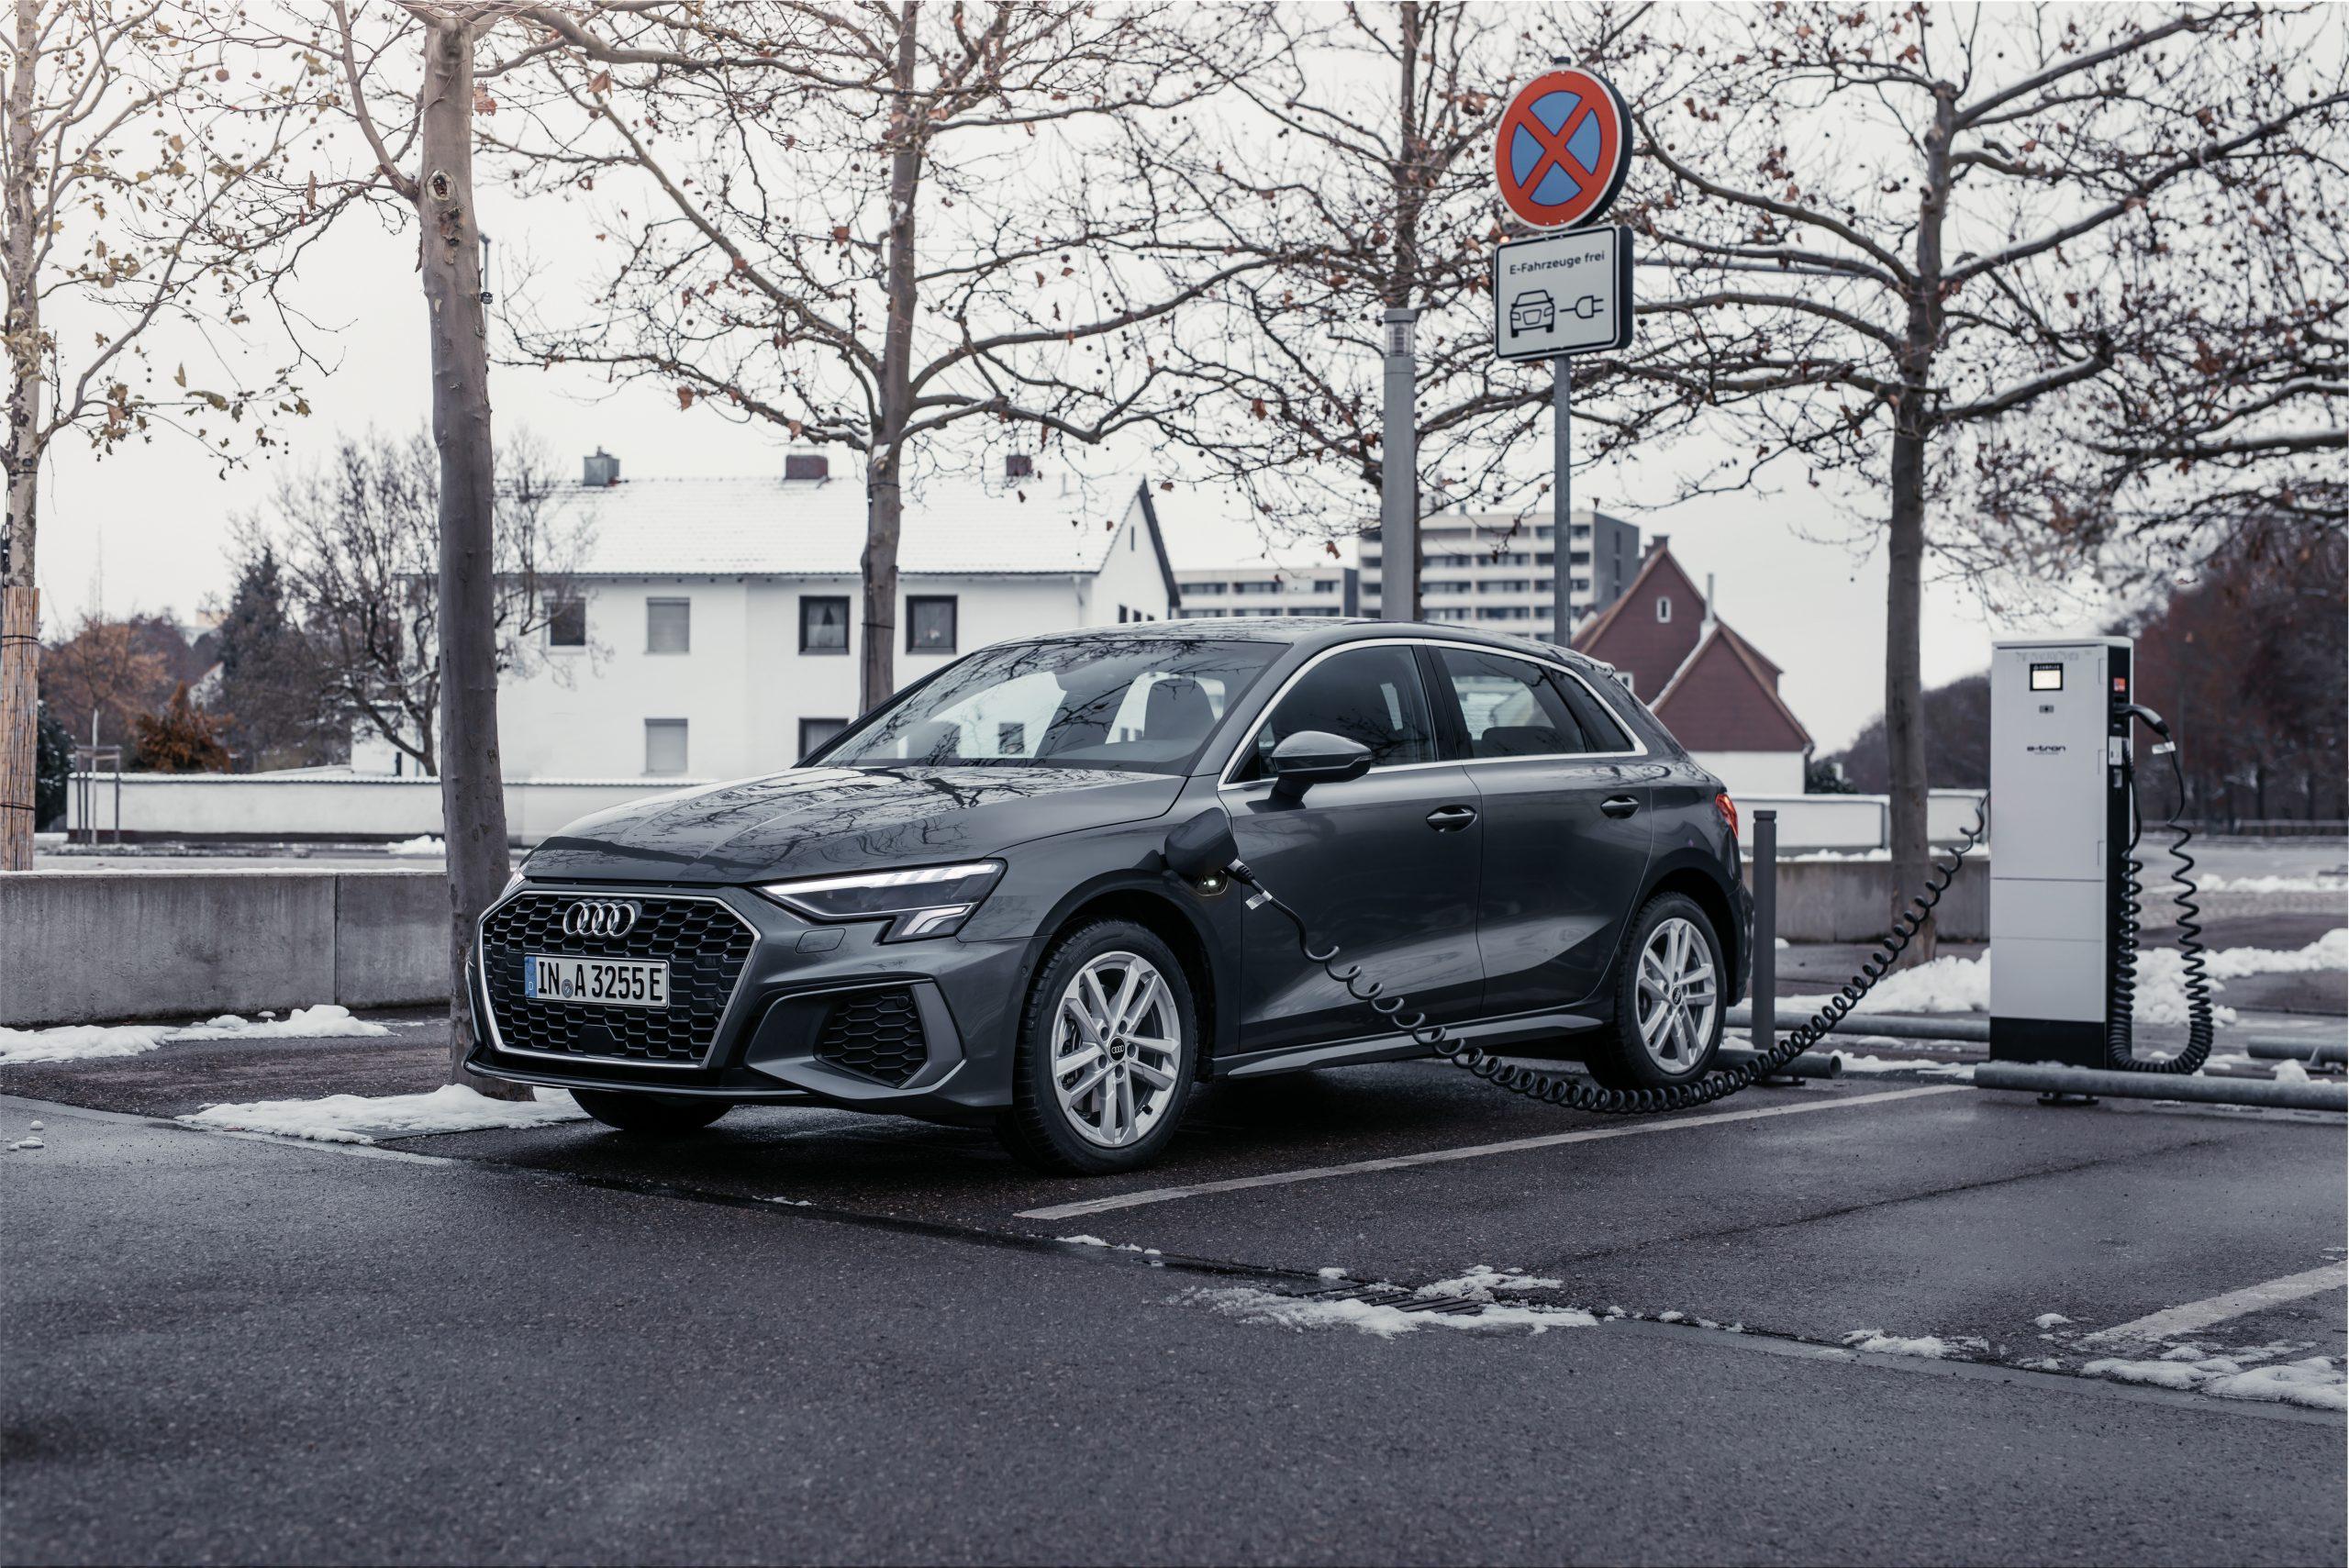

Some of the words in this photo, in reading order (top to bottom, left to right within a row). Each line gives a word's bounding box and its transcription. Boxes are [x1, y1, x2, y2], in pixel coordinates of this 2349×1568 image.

[1509, 256, 1581, 275] E-Fahrzeuge
[1585, 250, 1605, 262] frei
[538, 962, 560, 995] IN
